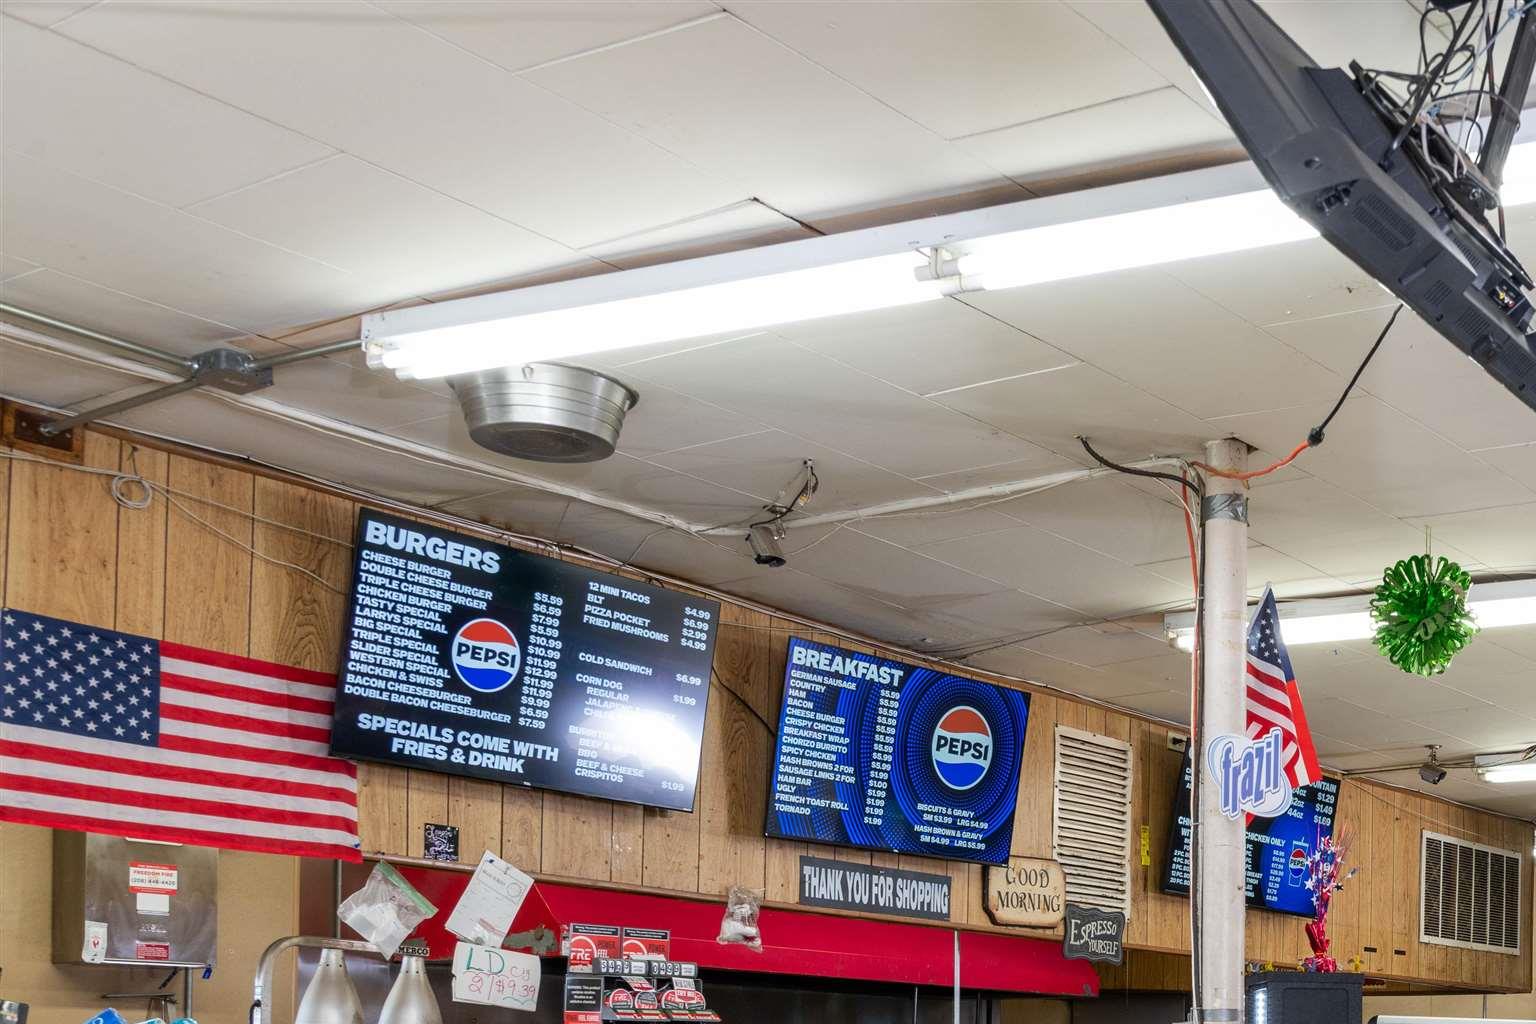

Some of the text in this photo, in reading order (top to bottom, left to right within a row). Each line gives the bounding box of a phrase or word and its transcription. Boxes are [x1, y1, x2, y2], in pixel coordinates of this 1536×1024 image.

[365, 520, 500, 574] BURGERS
[362, 550, 451, 579] CHEESE BURGER
[360, 561, 493, 600] DOUBLE CHEESE BURGER
[360, 573, 487, 610] TRIPLE CHEESE BURGER
[357, 595, 442, 621] TASTY SPECIAL
[358, 584, 452, 613] CHICKEN BURGER
[354, 617, 422, 639] BIG SPECIAL
[355, 606, 448, 634] LARRYS SPECIAL
[583, 615, 669, 642] FRIED MUSHROOMS
[585, 604, 650, 627] PIZZA POCKET
[457, 642, 517, 668] PEPSI
[579, 652, 652, 675] COLD SANDWICH
[793, 646, 904, 687] BREAKFAST
[790, 679, 826, 693] COUNTRY
[345, 685, 511, 724] DOUBLE BACON CHEESEBURGER
[787, 698, 814, 709] BACON
[357, 713, 559, 762] SPECIALS COME WITH
[784, 726, 850, 744] BREAKFAST WRAP
[936, 735, 989, 760] PEPSI
[392, 737, 524, 773] FRIES & DRINK
[1221, 733, 1281, 814] frazil
[774, 803, 810, 815] TORNADO
[776, 793, 849, 810] FRENCH TOAST ROLL
[1315, 804, 1333, 815] $1.49
[1317, 793, 1335, 804] $1.29
[1271, 834, 1286, 847] ONLY
[1005, 864, 1049, 889] GOOD
[803, 866, 950, 915] THANK YOU FOR SHOPPING
[996, 890, 1061, 913] MORNING
